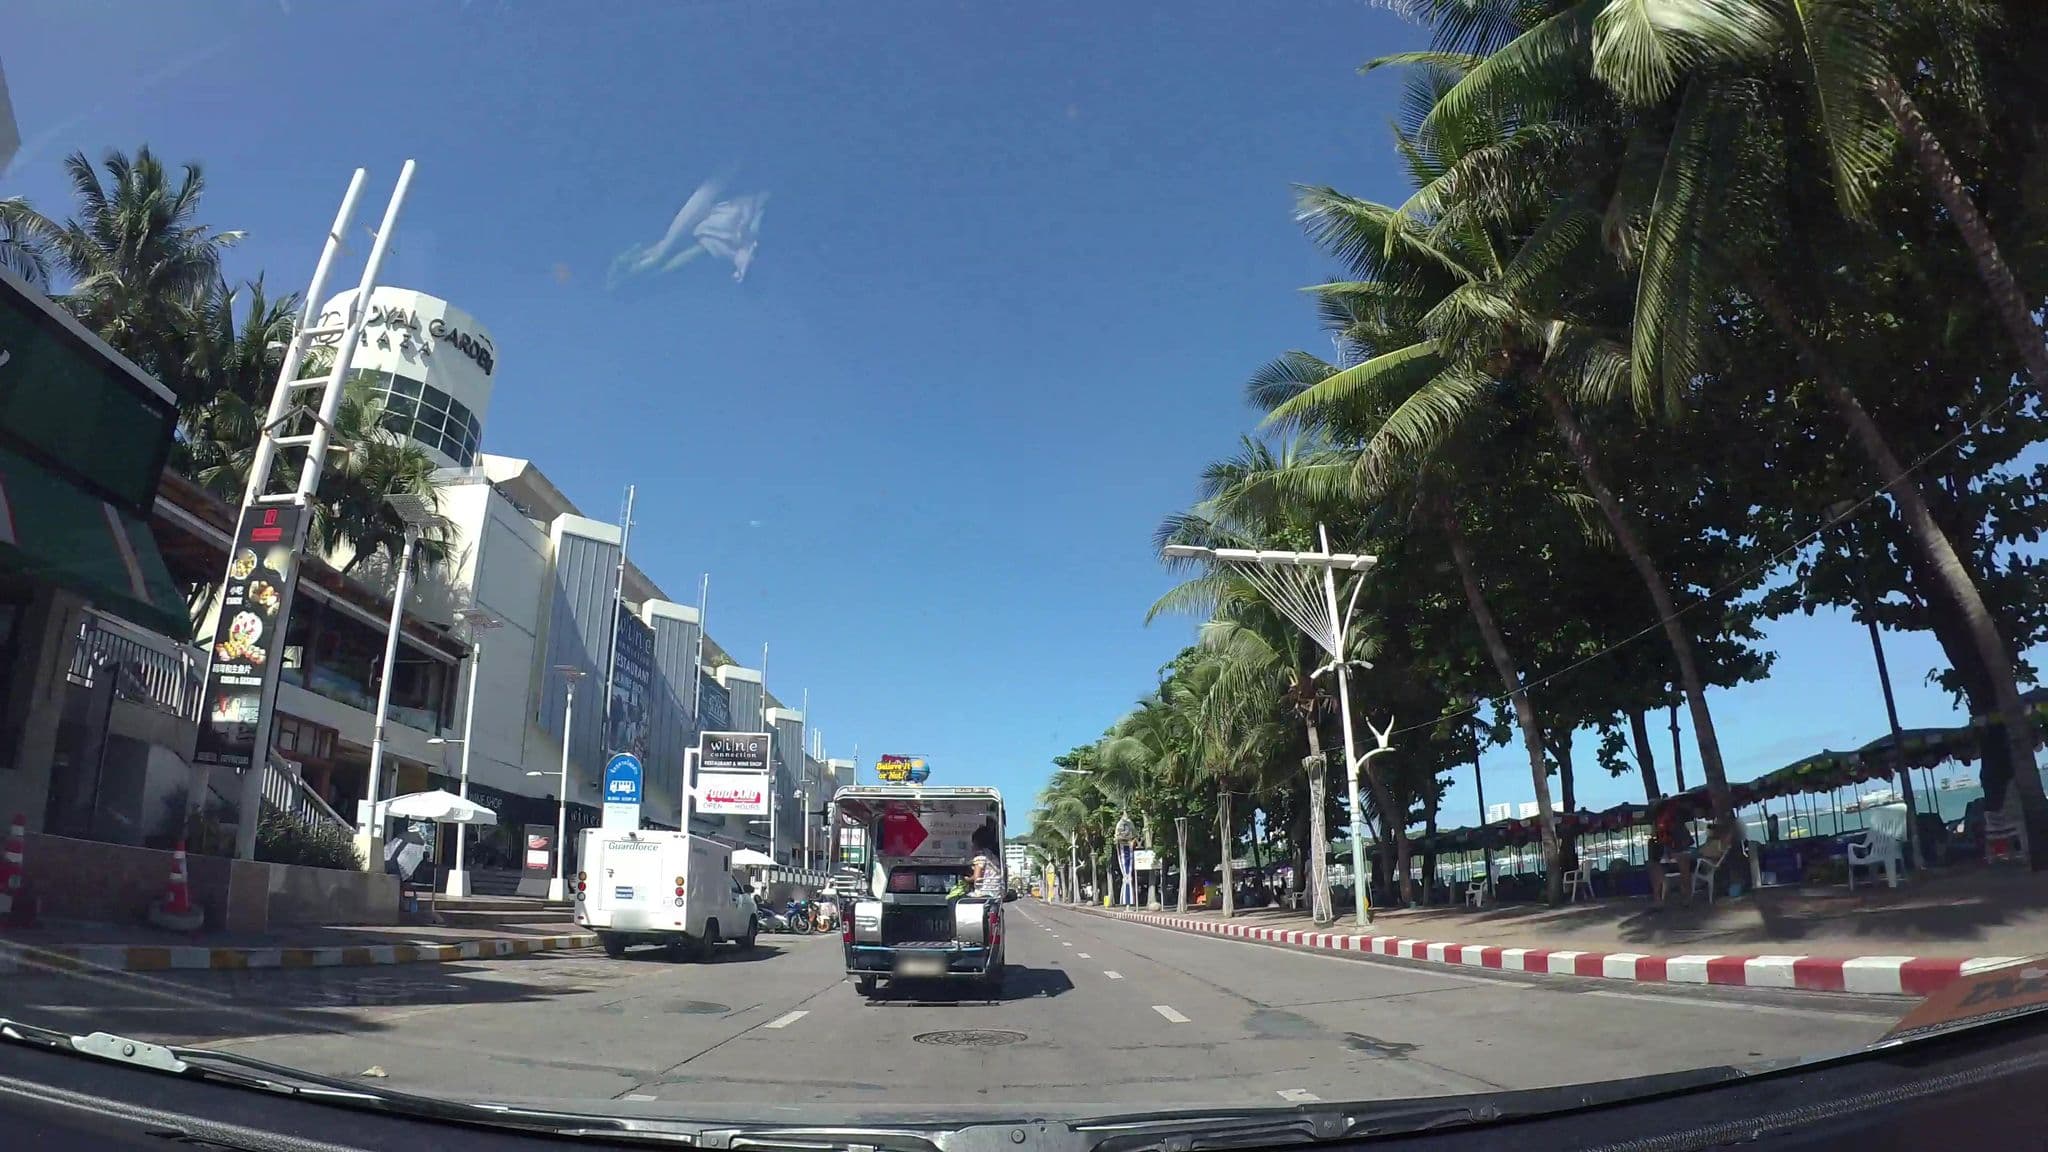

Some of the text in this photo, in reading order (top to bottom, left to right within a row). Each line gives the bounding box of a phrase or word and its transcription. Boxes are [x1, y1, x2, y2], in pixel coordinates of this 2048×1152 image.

[369, 304, 494, 376] OYAL GARDEN
[615, 651, 650, 685] ESTAURANT
[710, 737, 758, 752] wine
[608, 841, 659, 852] Guardforce
